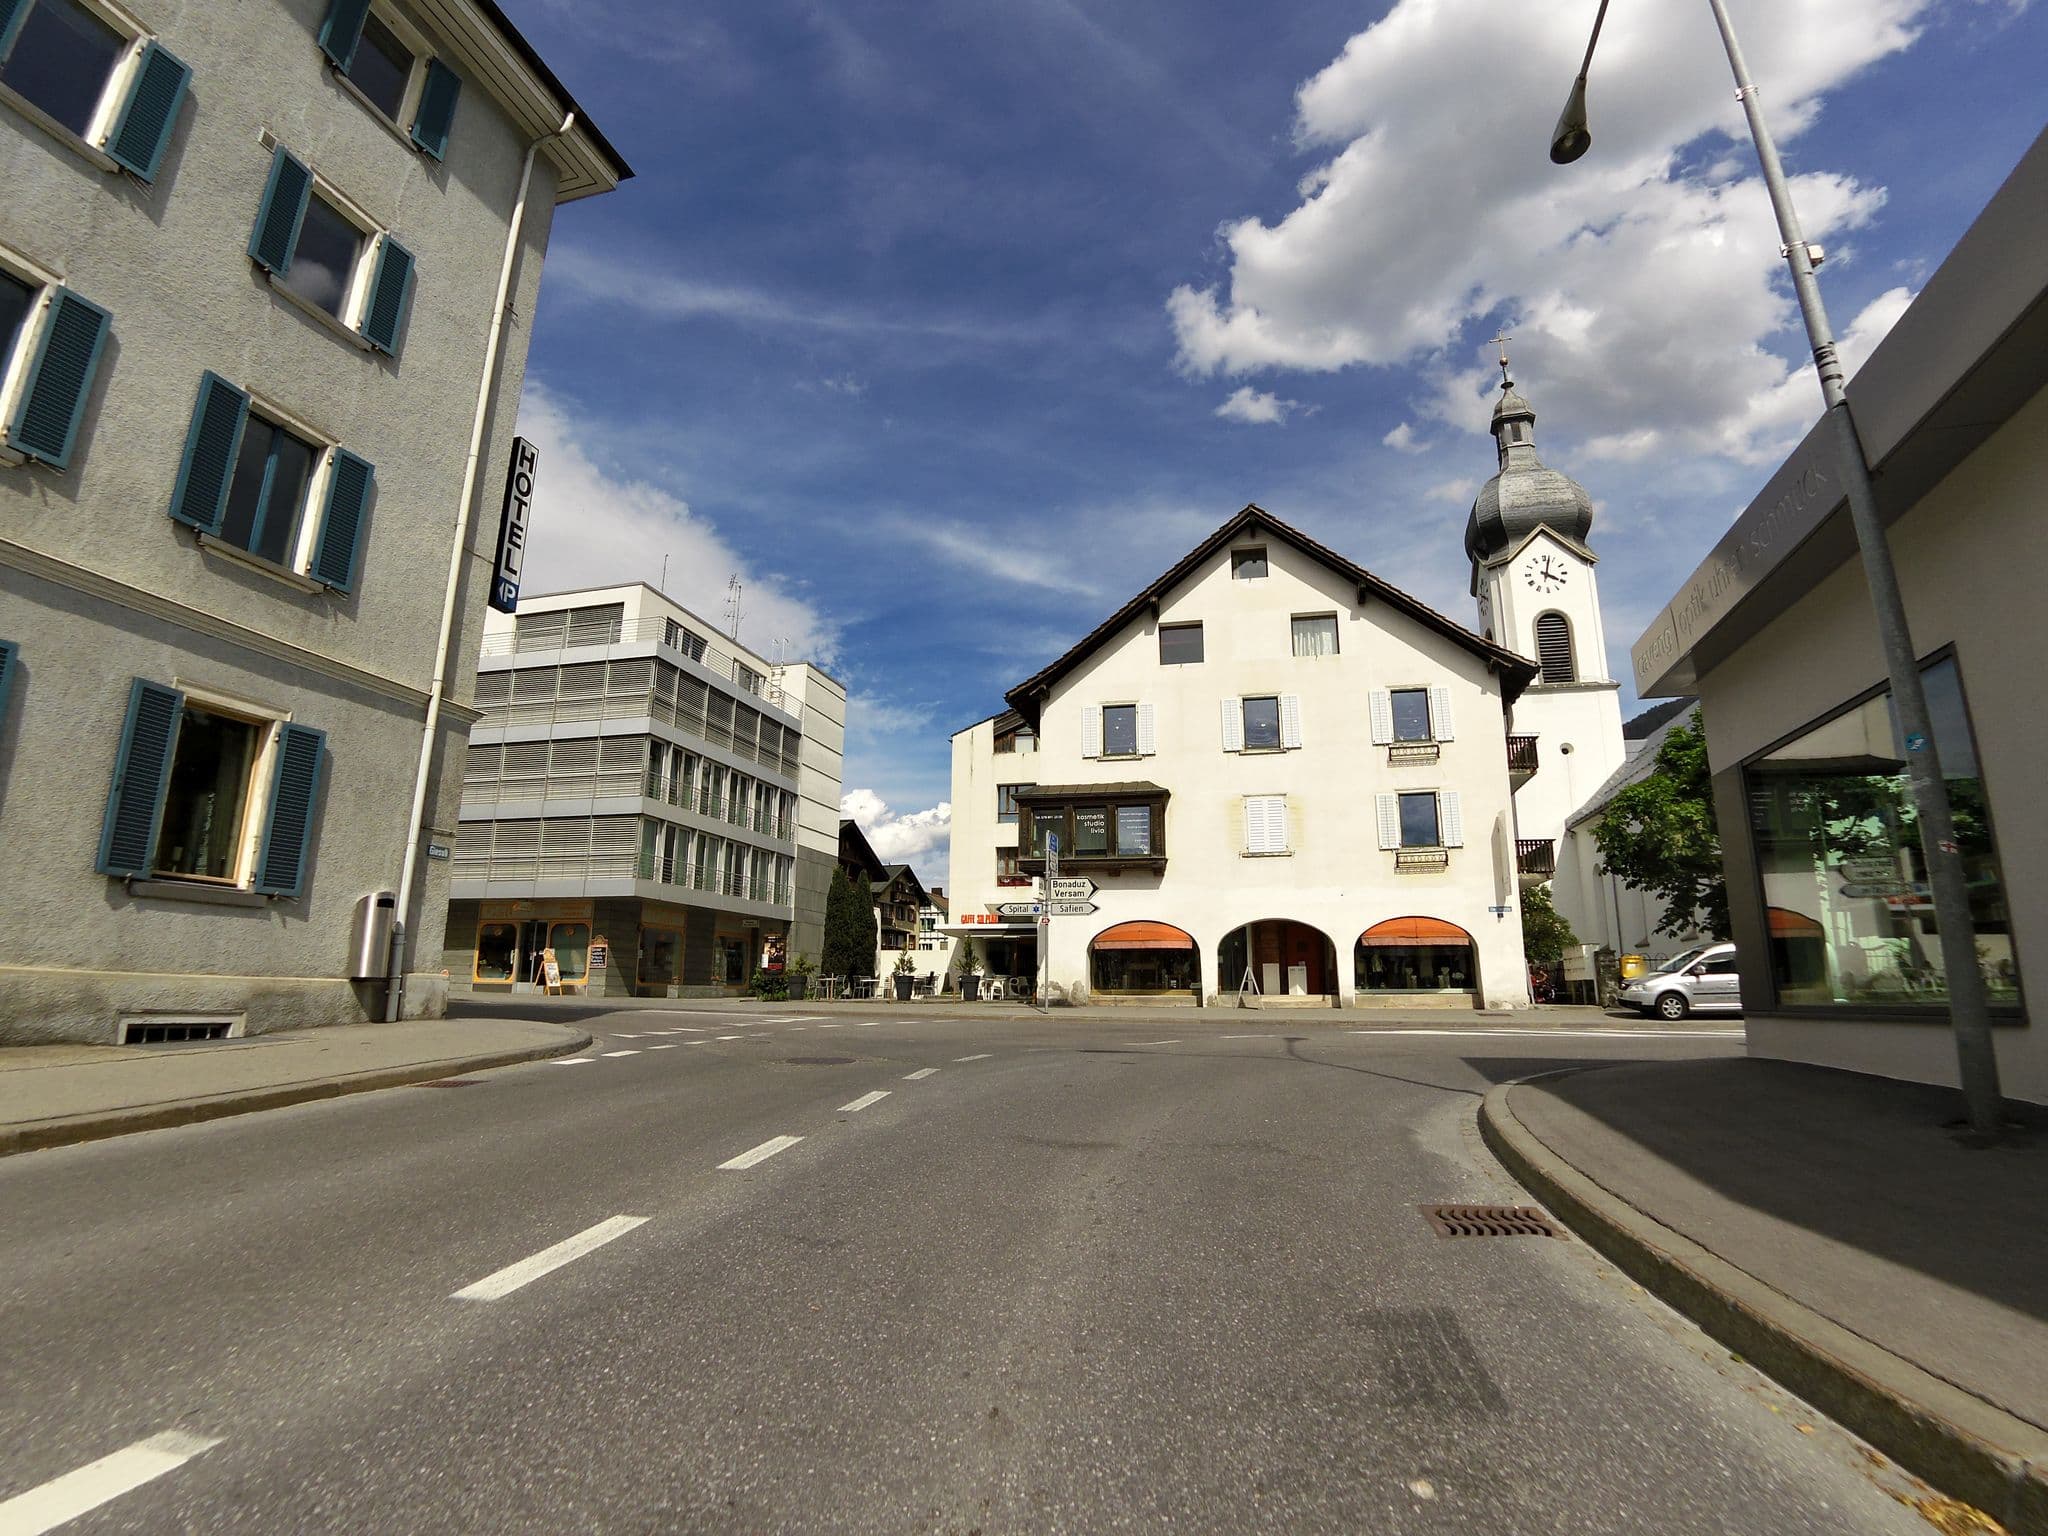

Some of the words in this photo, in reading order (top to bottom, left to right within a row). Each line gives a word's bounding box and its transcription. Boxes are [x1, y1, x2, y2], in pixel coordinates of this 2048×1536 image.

[504, 445, 535, 576] HOTEL
[1053, 880, 1086, 888] Bonaduz
[1008, 904, 1029, 914] Spital
[1060, 904, 1084, 913] Safien
